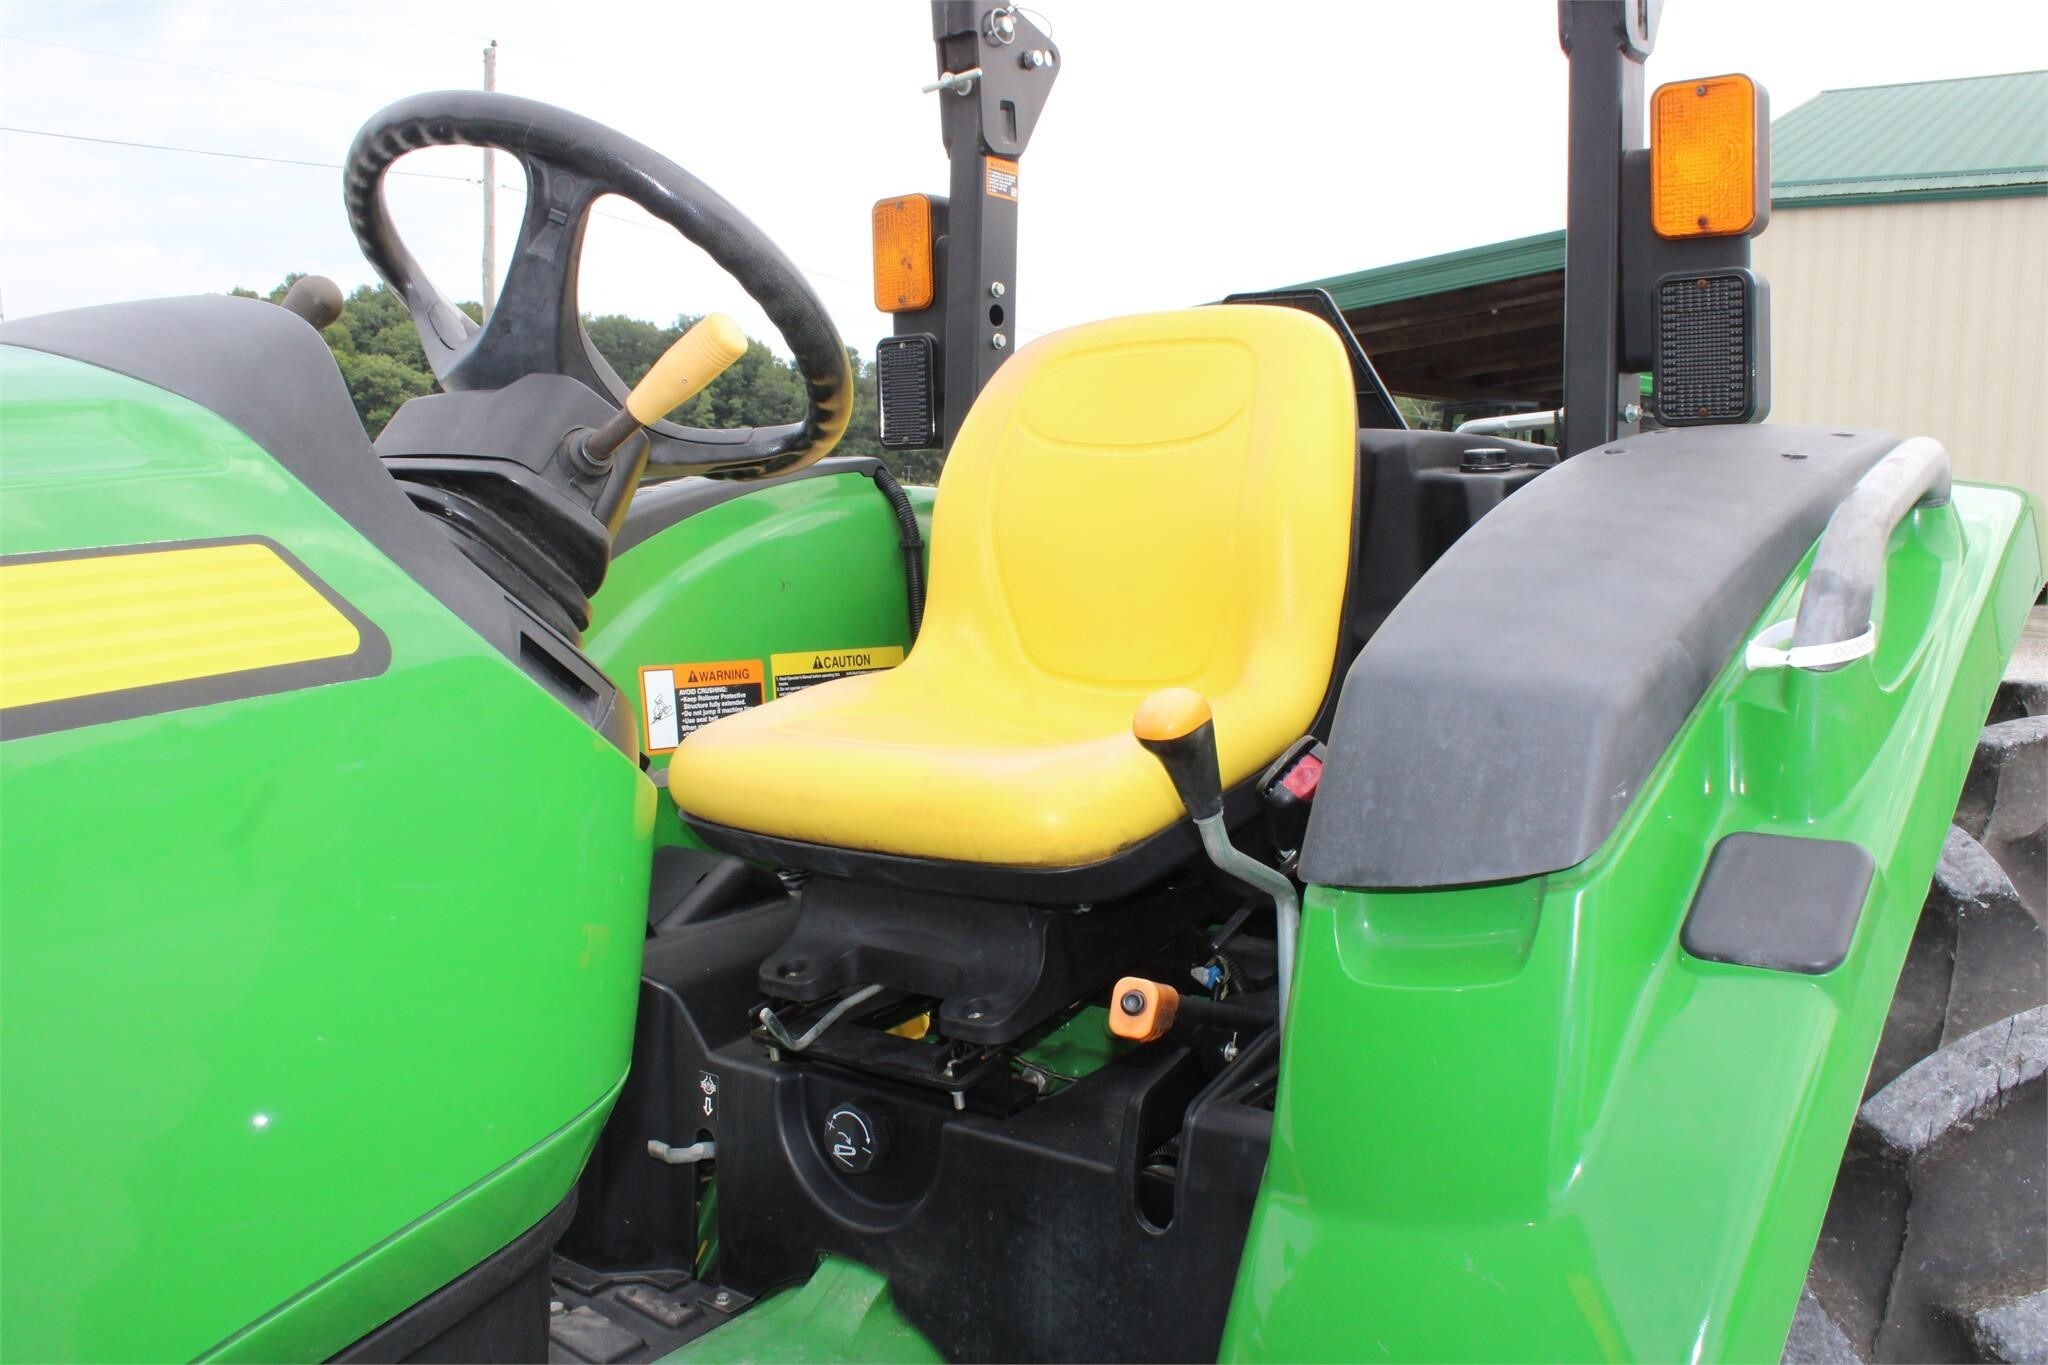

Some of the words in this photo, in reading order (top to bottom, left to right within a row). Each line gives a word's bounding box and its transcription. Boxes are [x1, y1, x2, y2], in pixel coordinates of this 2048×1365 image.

[824, 654, 871, 669] CAUTION
[699, 669, 750, 682] WARNING
[679, 688, 696, 696] AVOID
[698, 694, 720, 702] Rollover
[683, 702, 709, 710] Structure
[709, 700, 721, 709] fully
[693, 709, 702, 717] not
[702, 708, 717, 718] jump
[696, 716, 708, 724] seat
